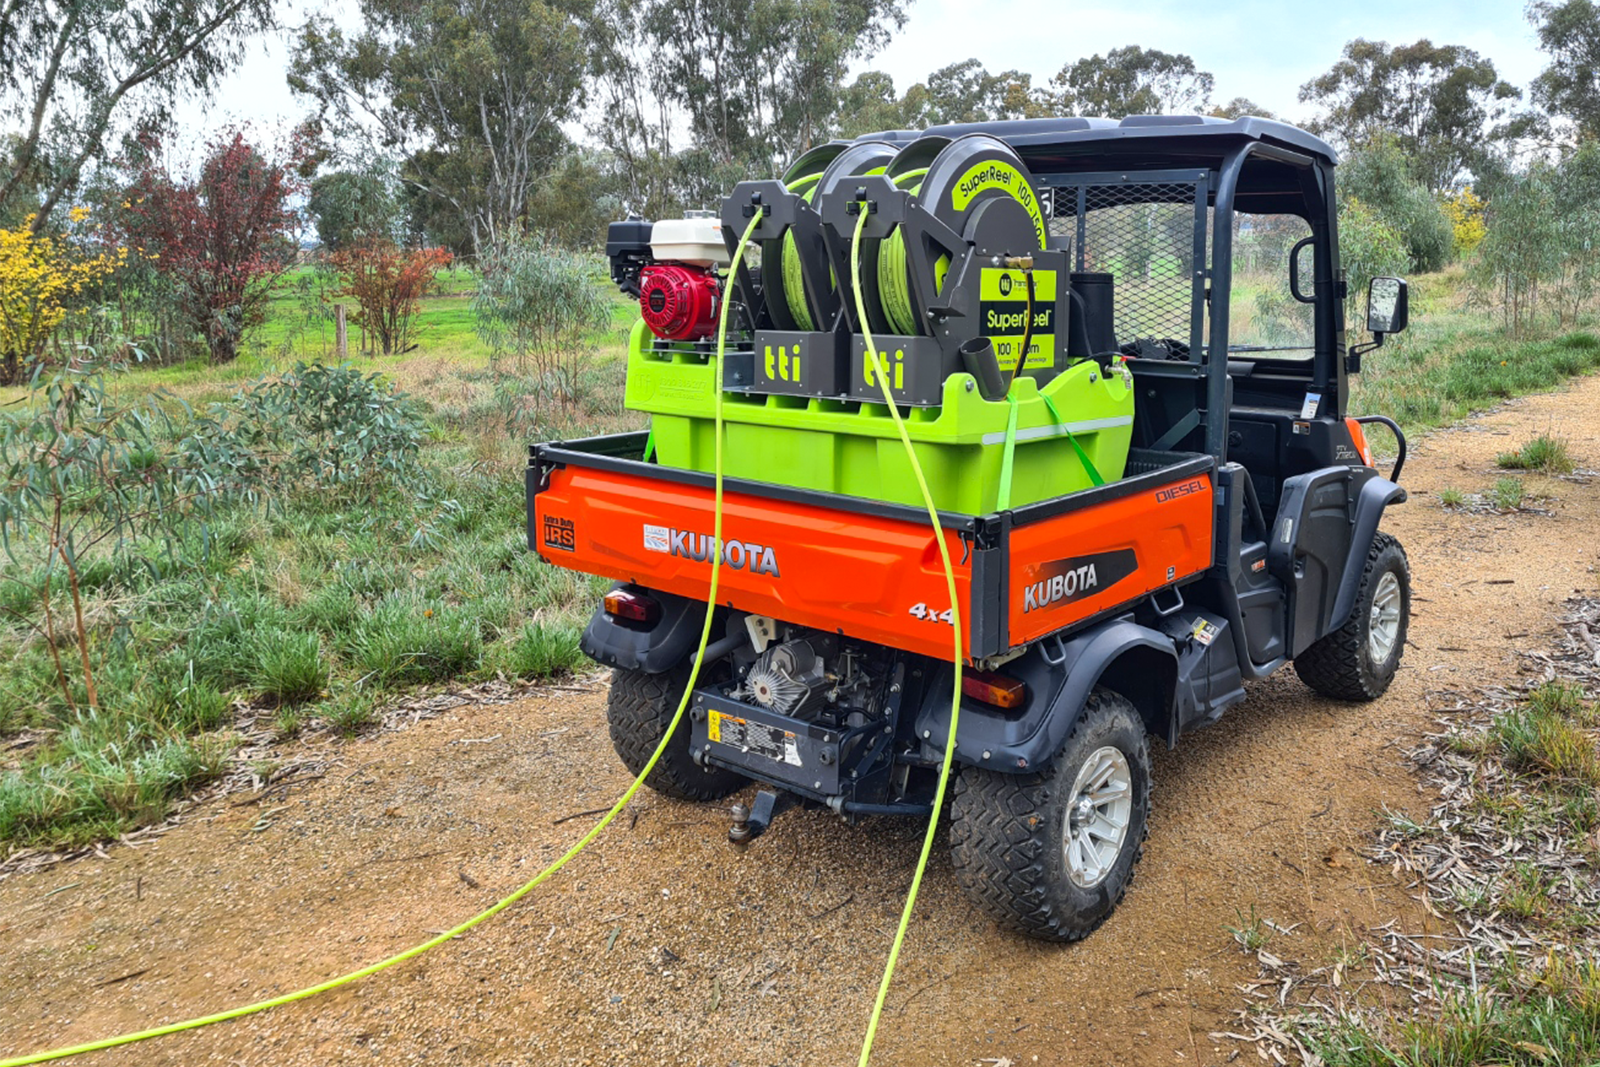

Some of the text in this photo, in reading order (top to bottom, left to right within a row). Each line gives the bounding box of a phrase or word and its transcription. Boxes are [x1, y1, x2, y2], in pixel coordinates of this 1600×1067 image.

[764, 343, 801, 382] tti
[1155, 480, 1208, 504] DIESEL
[545, 525, 574, 546] IRS
[670, 527, 781, 578] KUBOTA
[1023, 563, 1098, 614] KUBOTA
[908, 602, 955, 626] 4x4
